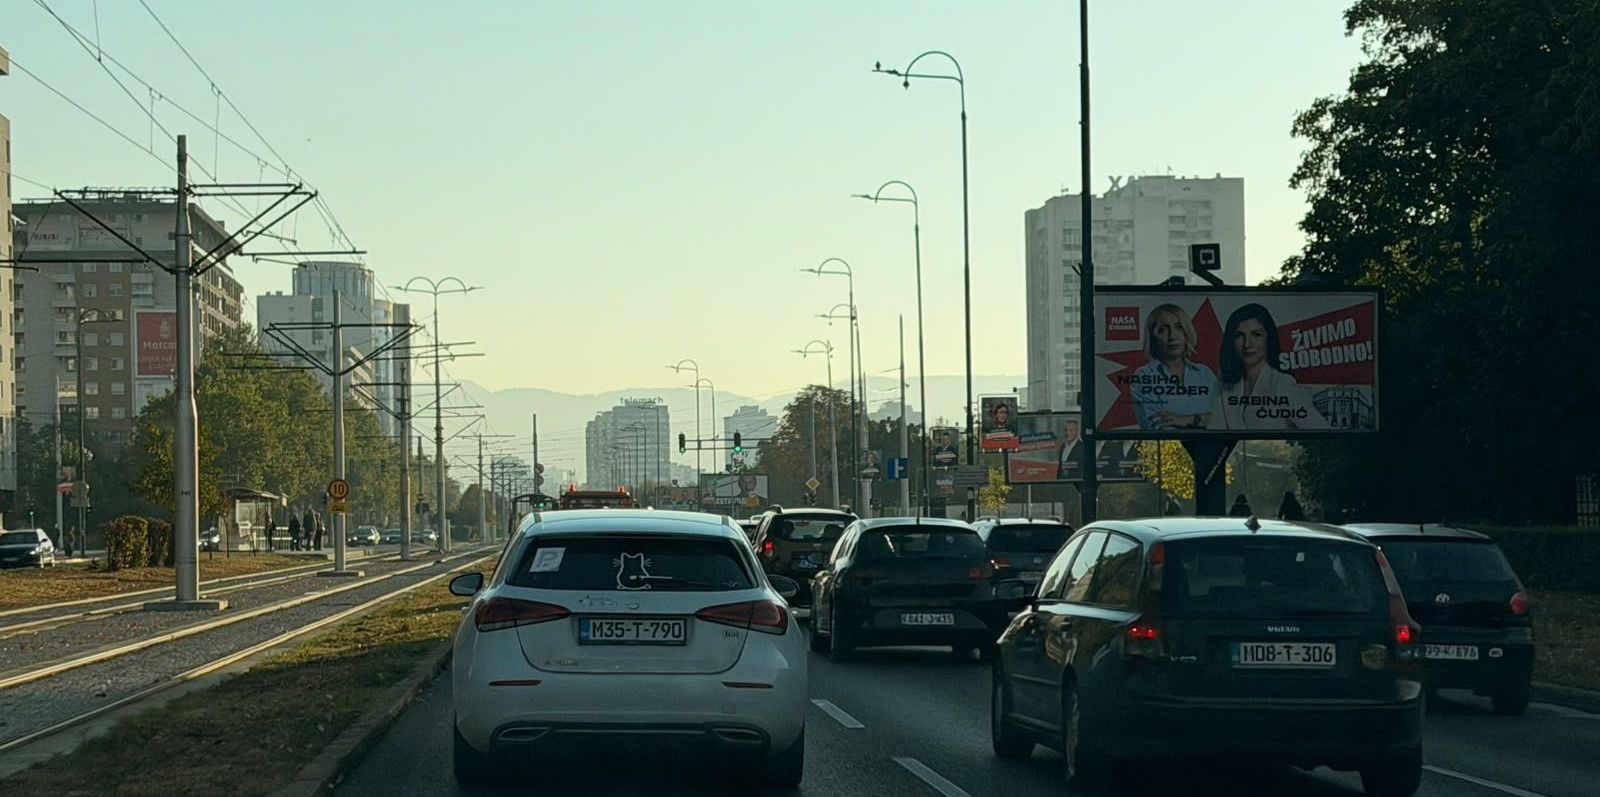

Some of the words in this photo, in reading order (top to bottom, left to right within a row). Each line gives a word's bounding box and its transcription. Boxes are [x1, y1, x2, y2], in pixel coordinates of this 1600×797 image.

[1291, 317, 1358, 352] ŽIVIMO
[1279, 340, 1374, 371] SLOBODNO!
[1118, 375, 1180, 385] NASIHA
[1142, 385, 1209, 396] POZDER
[620, 396, 664, 404] telemach
[1228, 396, 1289, 406] SABINA
[1256, 406, 1308, 419] ĆUDIĆ
[334, 484, 345, 495] 10
[592, 622, 682, 641] M35-T-790
